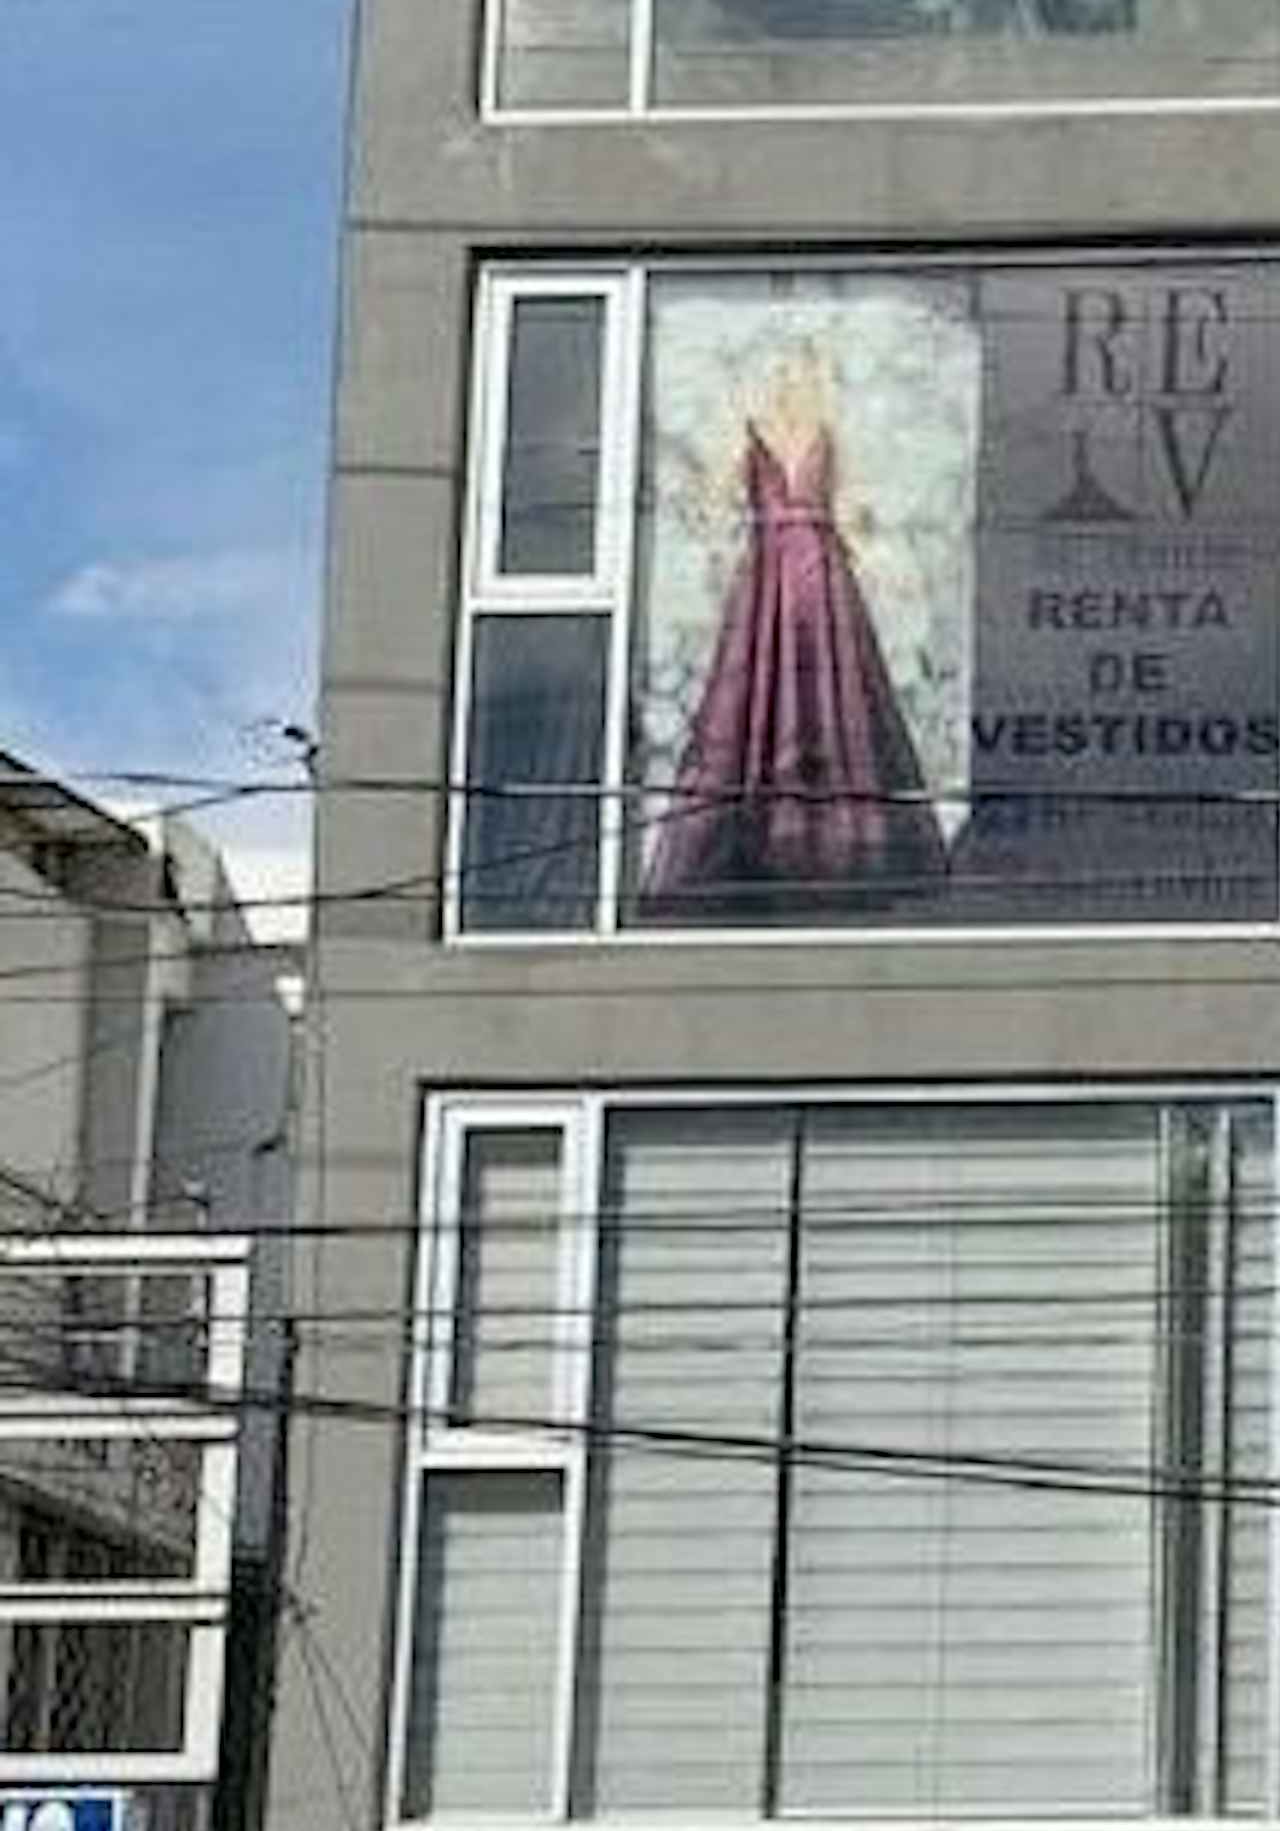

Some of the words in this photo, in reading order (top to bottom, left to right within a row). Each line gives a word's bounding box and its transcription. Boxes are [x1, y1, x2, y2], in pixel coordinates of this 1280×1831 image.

[1026, 586, 1233, 631] RENTA
[1089, 652, 1172, 693] DE
[971, 714, 1280, 756] VESTIDOS
